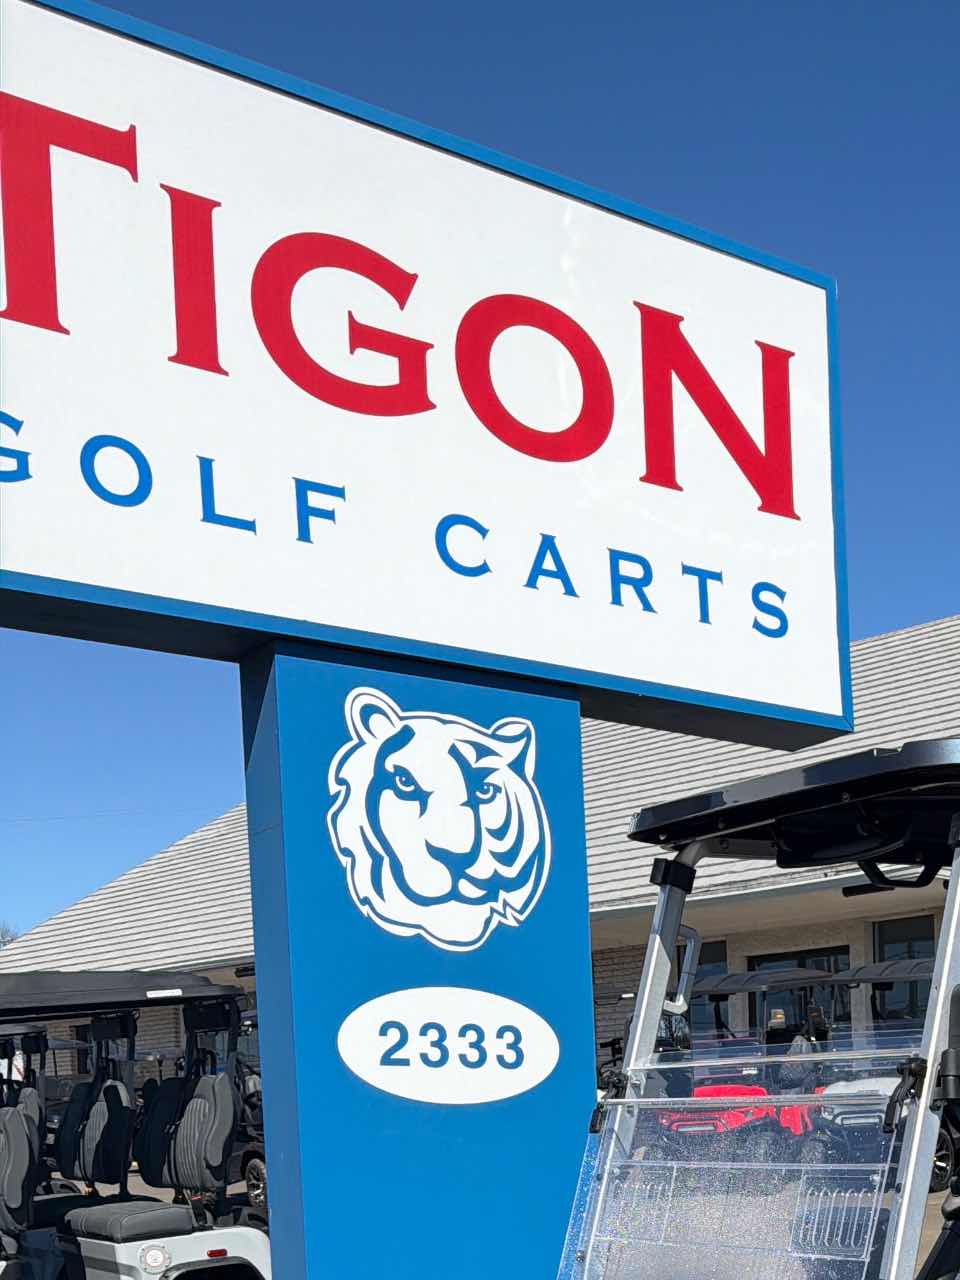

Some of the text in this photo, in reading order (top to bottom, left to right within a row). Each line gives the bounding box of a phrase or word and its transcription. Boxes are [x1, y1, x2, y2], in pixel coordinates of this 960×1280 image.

[0, 92, 800, 520] TIGON
[434, 513, 789, 639] CARTS
[378, 1020, 525, 1070] 2333
